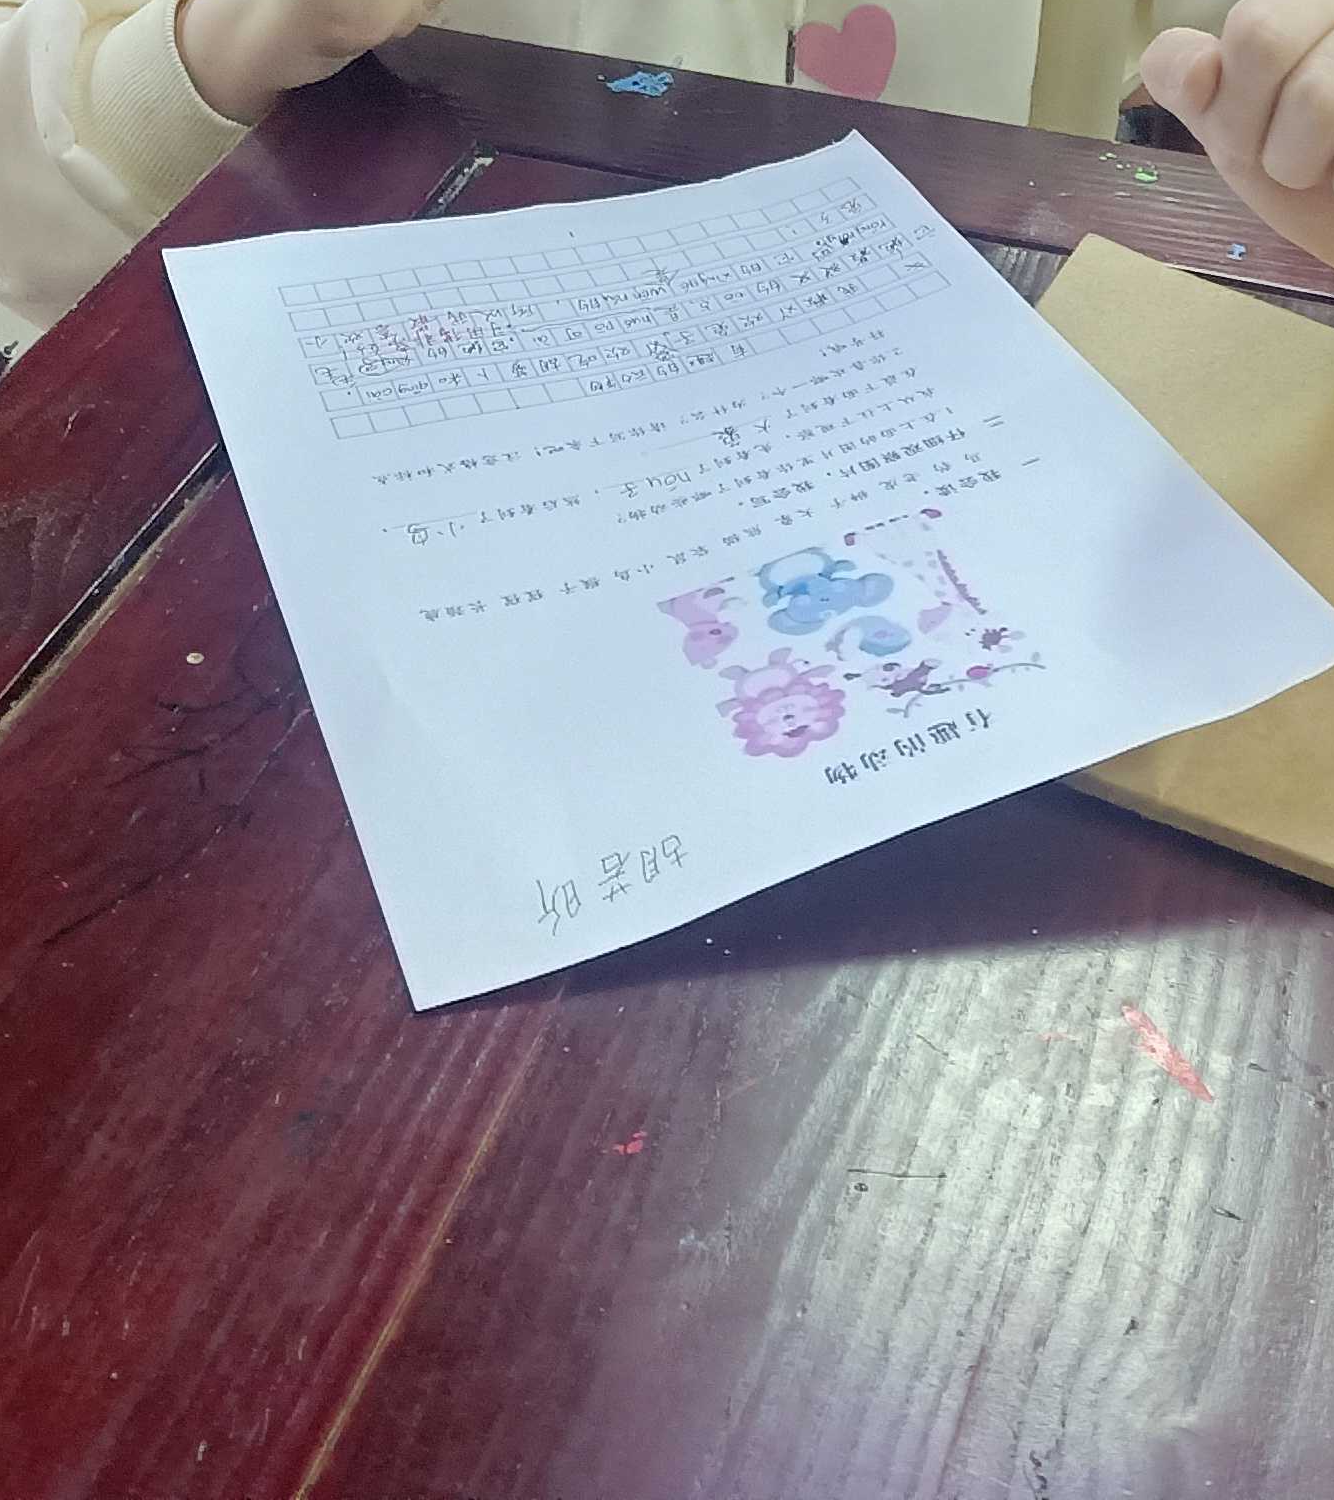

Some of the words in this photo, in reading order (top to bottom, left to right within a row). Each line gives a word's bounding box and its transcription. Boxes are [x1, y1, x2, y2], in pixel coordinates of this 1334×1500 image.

[823, 708, 992, 785] 有趣的动物
